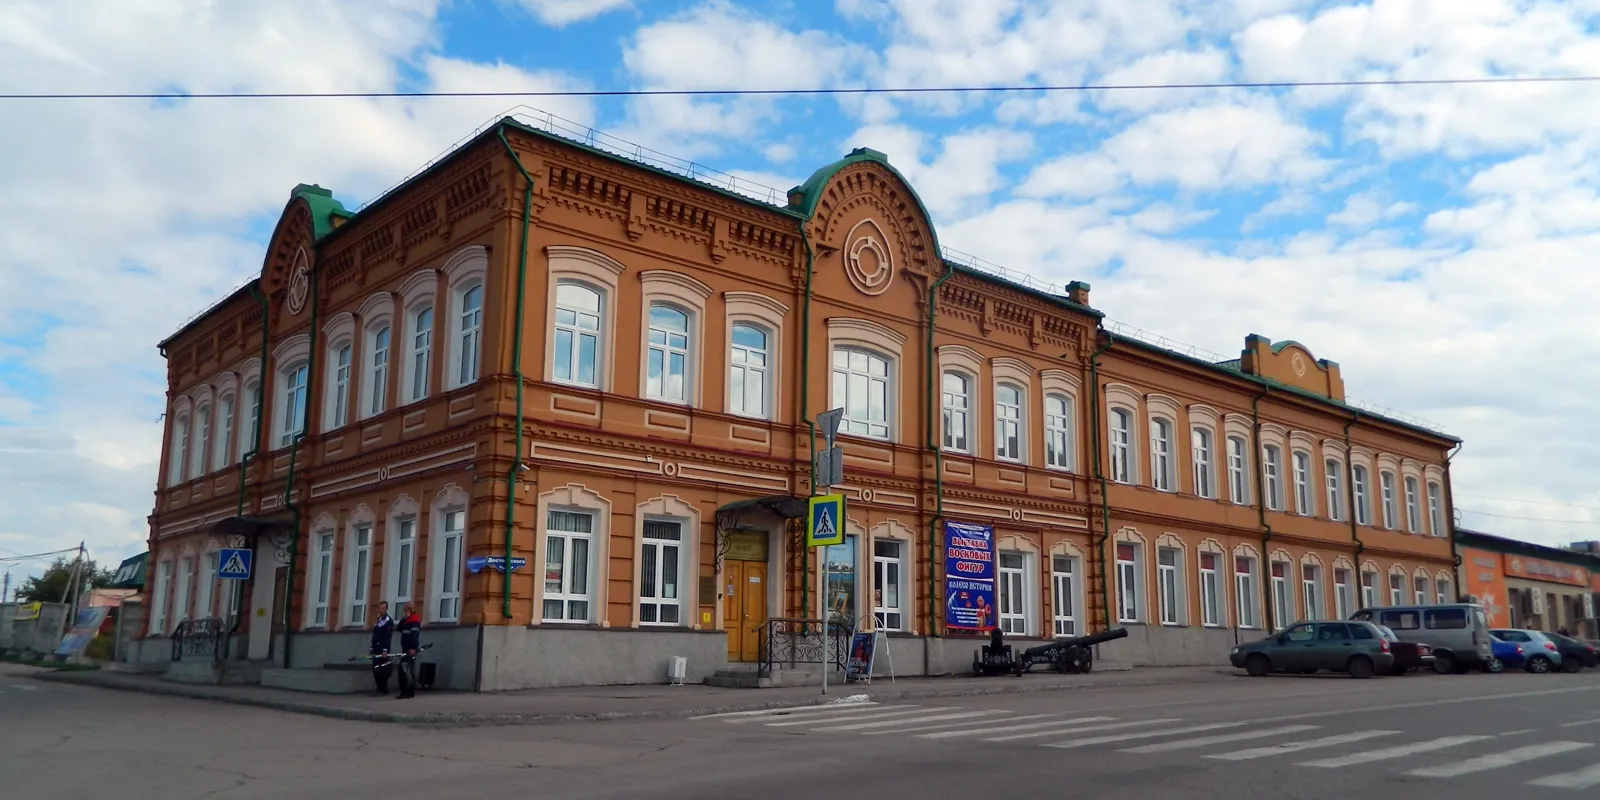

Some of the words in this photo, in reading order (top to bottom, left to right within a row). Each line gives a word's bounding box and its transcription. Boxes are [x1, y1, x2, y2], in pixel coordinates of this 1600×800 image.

[952, 538, 988, 549] ВЫСТАВКА
[949, 548, 991, 562] ВОСКОВЫХ
[956, 562, 984, 572] ФИГУР
